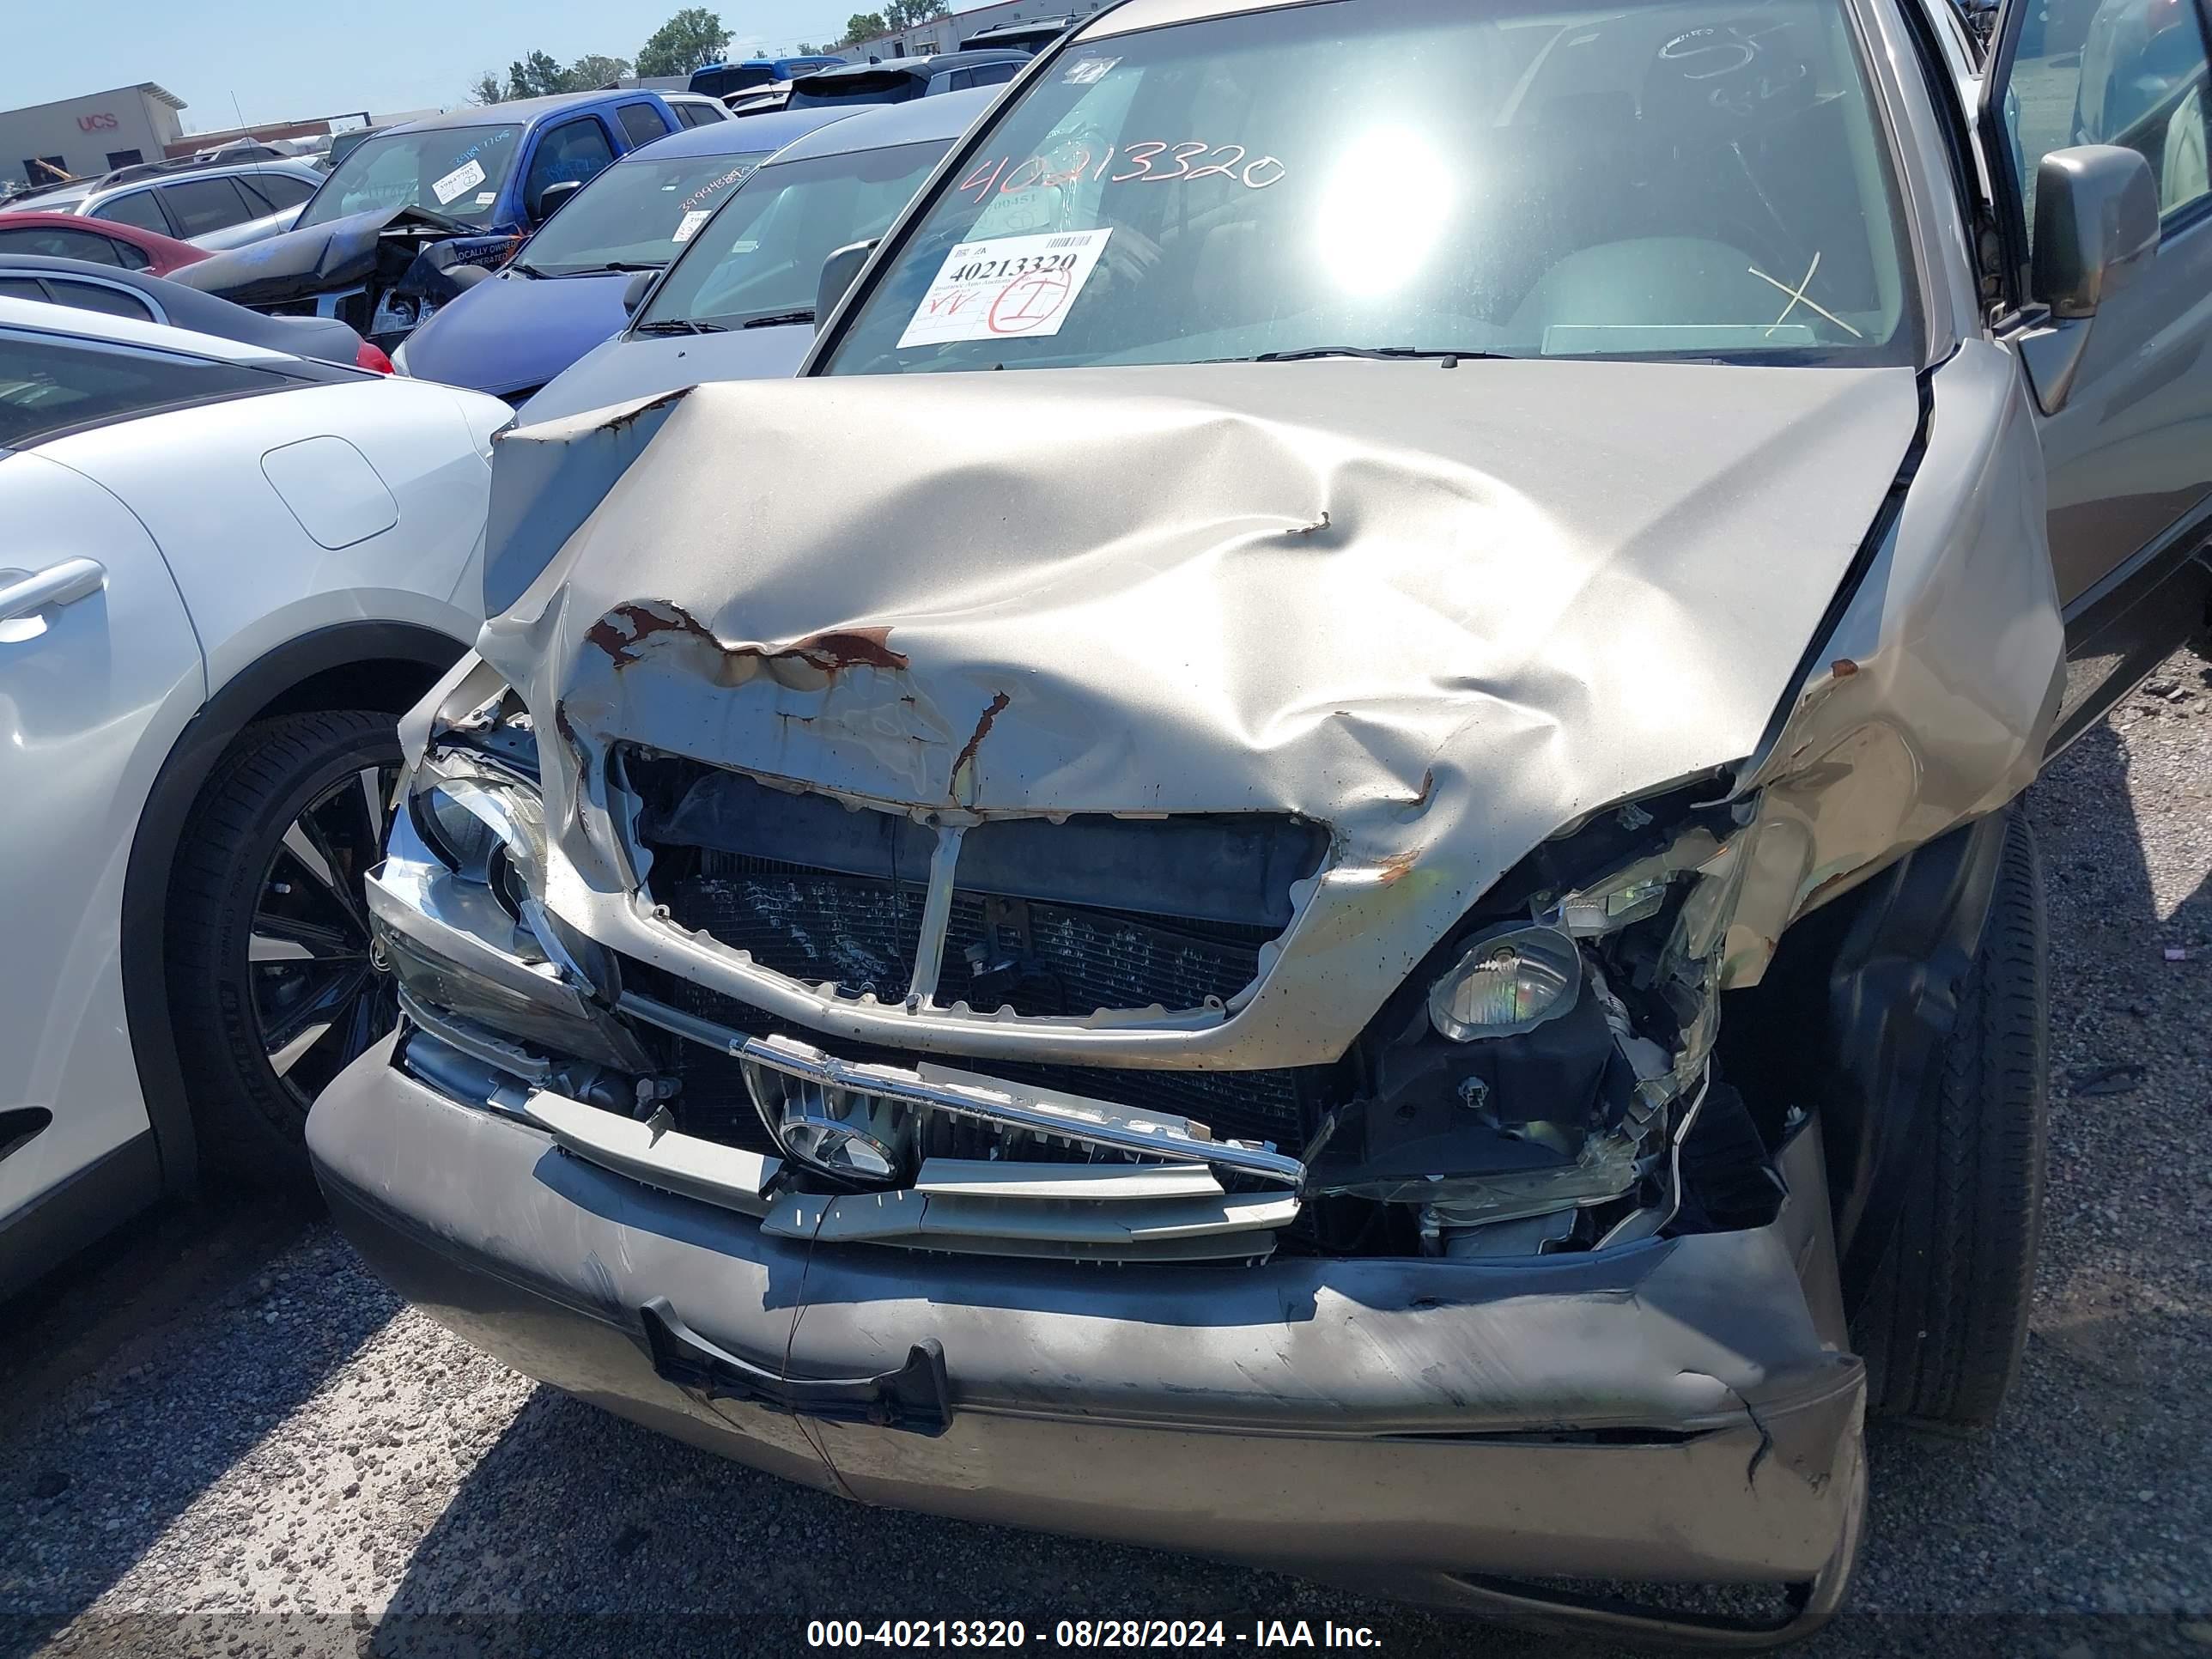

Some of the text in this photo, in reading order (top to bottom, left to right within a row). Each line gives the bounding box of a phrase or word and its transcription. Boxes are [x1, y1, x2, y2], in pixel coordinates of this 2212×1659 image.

[76, 112, 118, 131] UCS
[959, 141, 1286, 204] 40213320
[455, 240, 516, 261] LOCALLY OWNED
[470, 252, 508, 265] OPERATED
[949, 253, 1078, 283] 40213320
